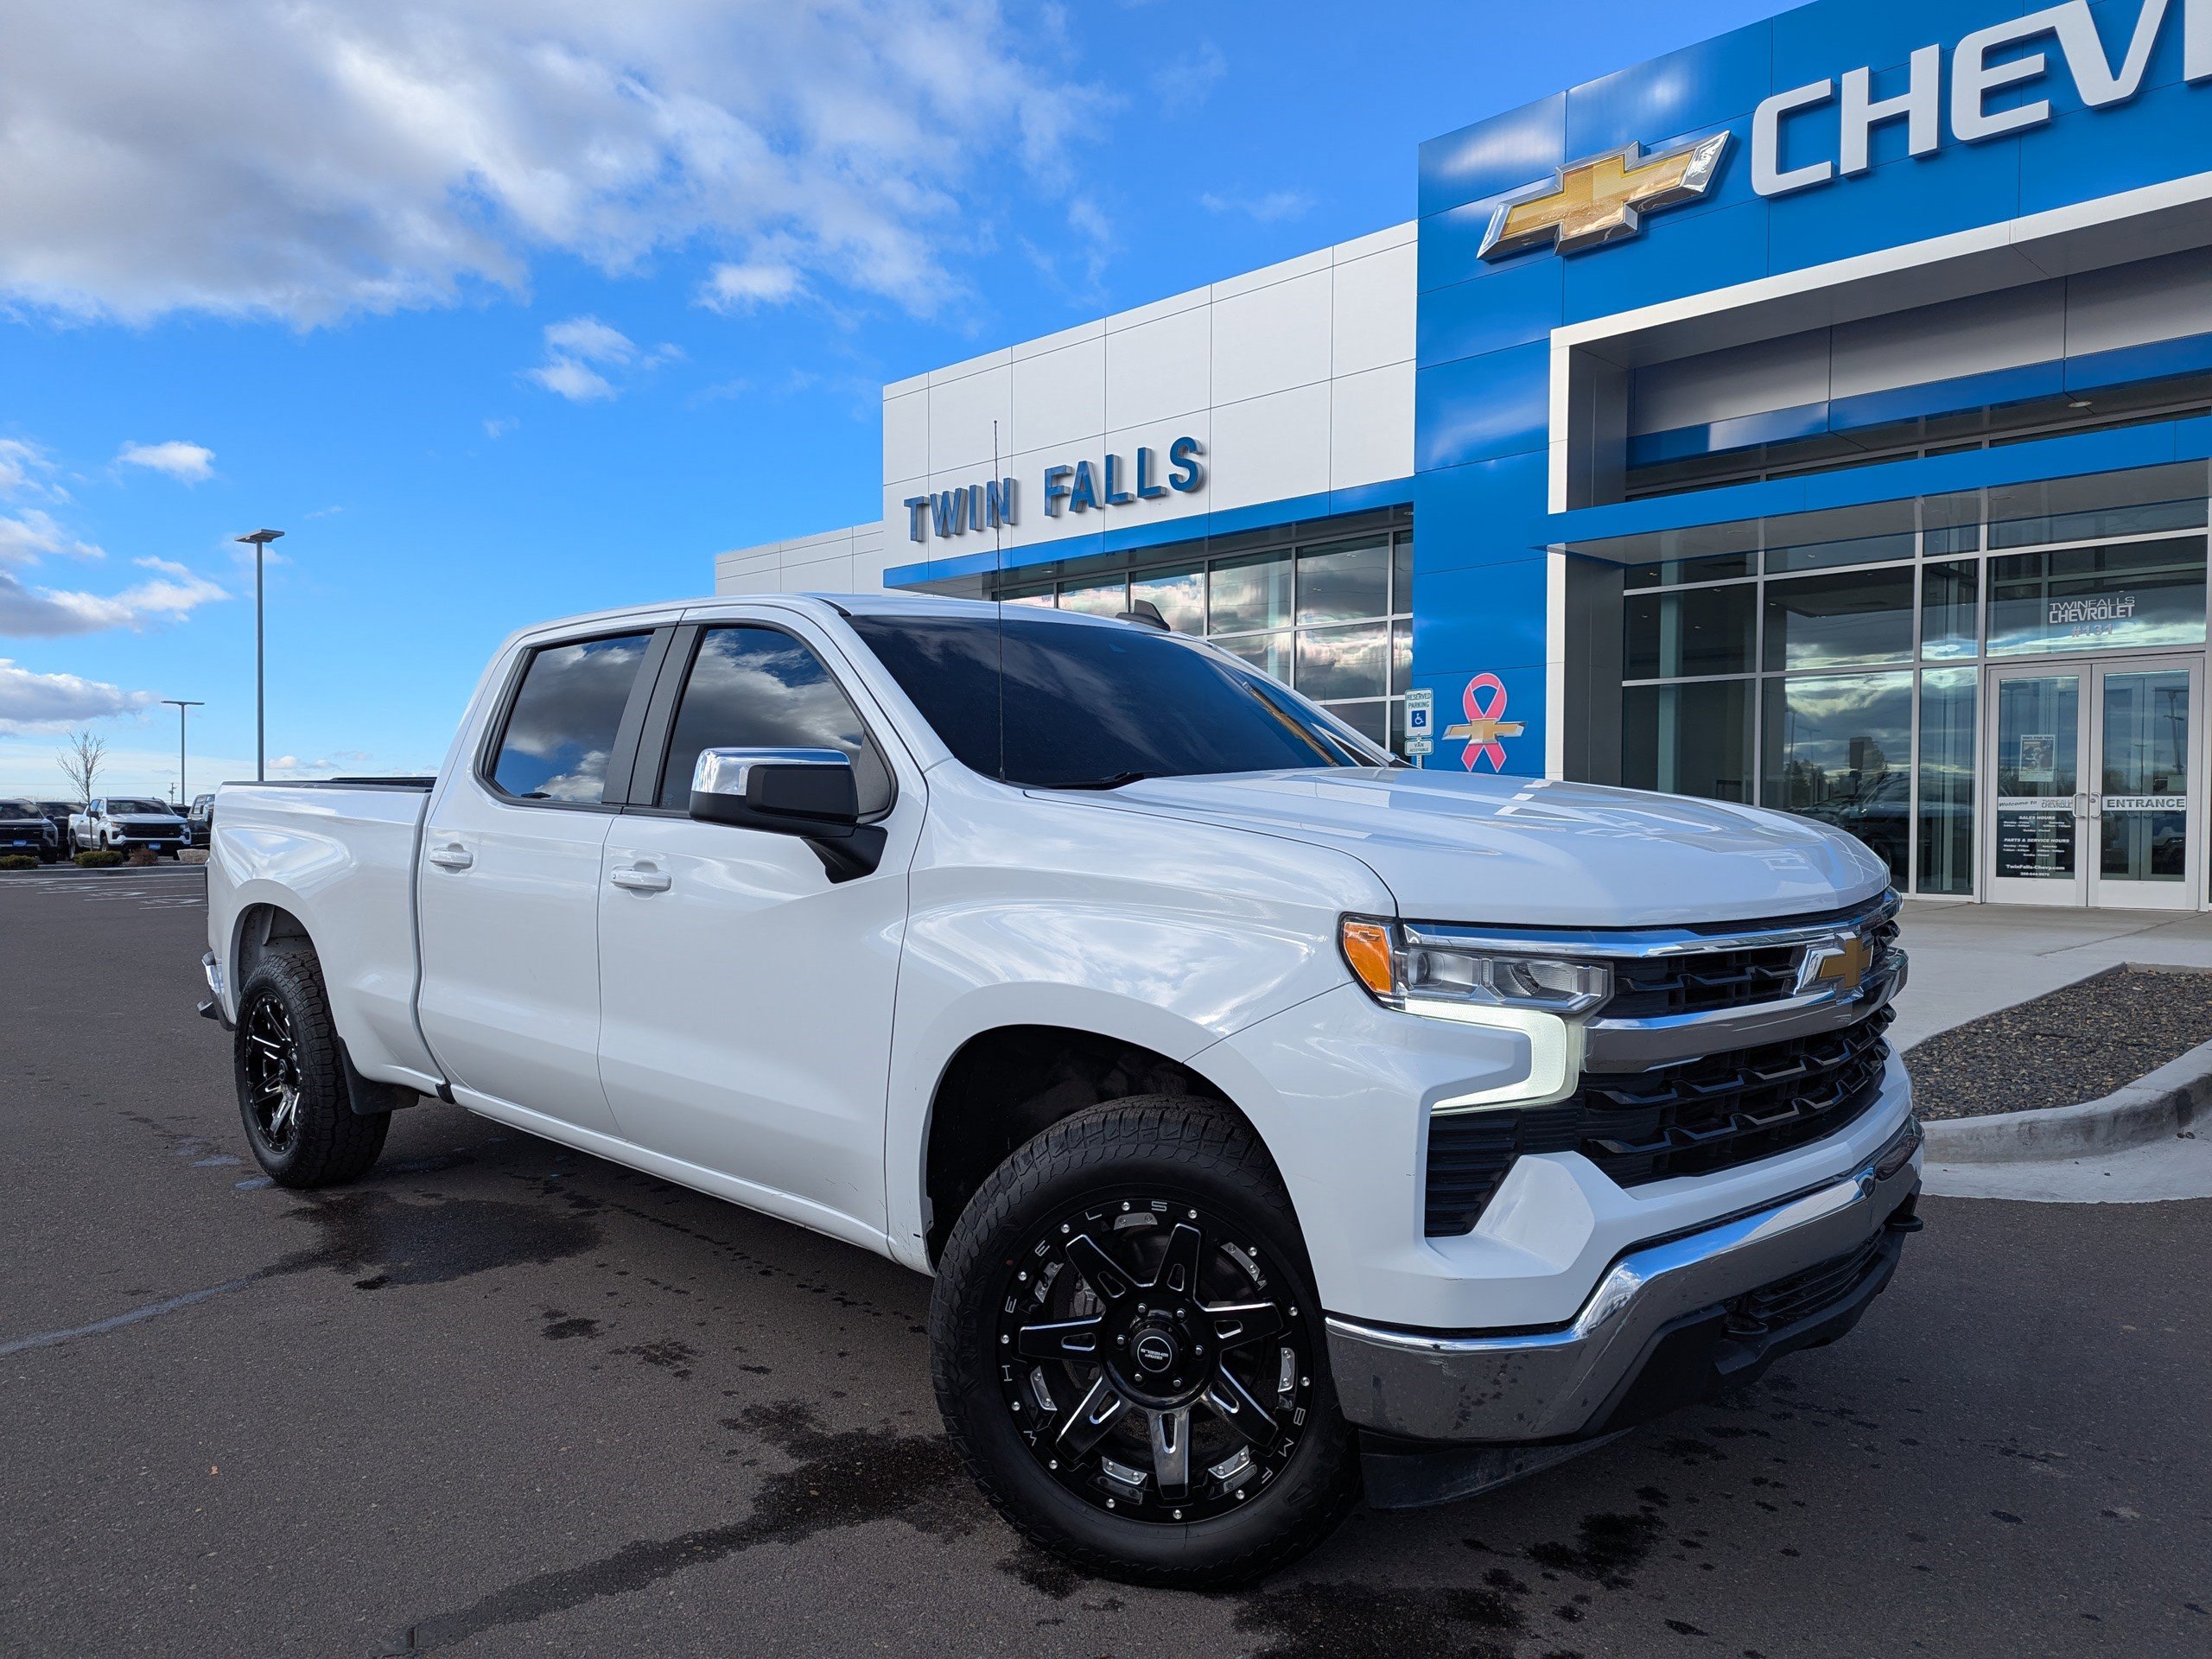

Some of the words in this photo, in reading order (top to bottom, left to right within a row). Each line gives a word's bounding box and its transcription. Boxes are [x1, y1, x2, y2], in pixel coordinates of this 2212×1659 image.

[1751, 0, 2212, 198] CHEV
[904, 477, 1017, 542] TWIN
[1045, 436, 1205, 517] FALLS
[2049, 604, 2135, 623] CHEVROLET
[2050, 596, 2135, 611] TWINFALLS
[2071, 624, 2113, 638] #131
[2107, 798, 2185, 808] ENTRANCE
[1001, 1200, 1168, 1447] WHEELS
[1261, 1406, 1306, 1484] BMF
